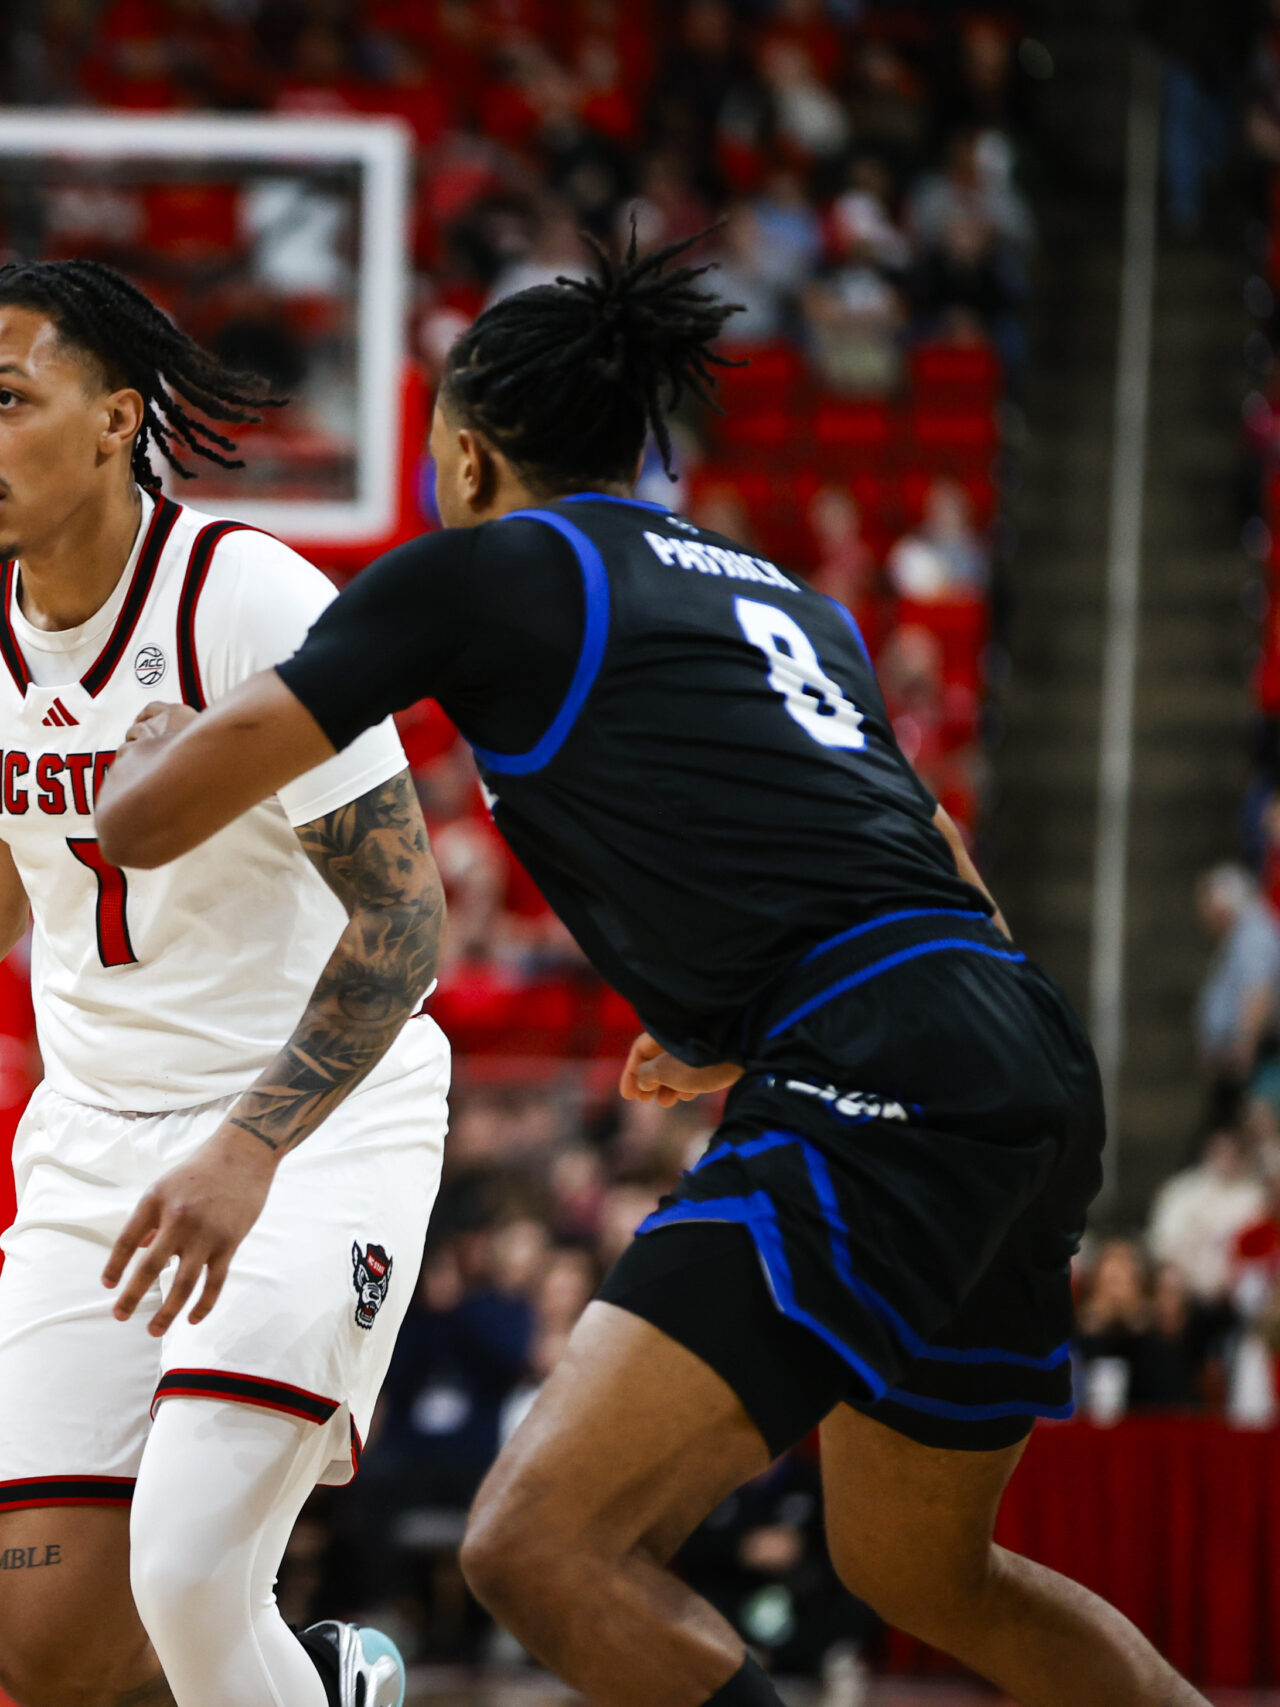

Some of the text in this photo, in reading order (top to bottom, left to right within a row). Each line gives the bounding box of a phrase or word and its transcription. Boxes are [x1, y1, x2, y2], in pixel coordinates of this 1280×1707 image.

[642, 530, 803, 594] PATRICK
[138, 657, 164, 668] ACC
[65, 836, 139, 968] 1
